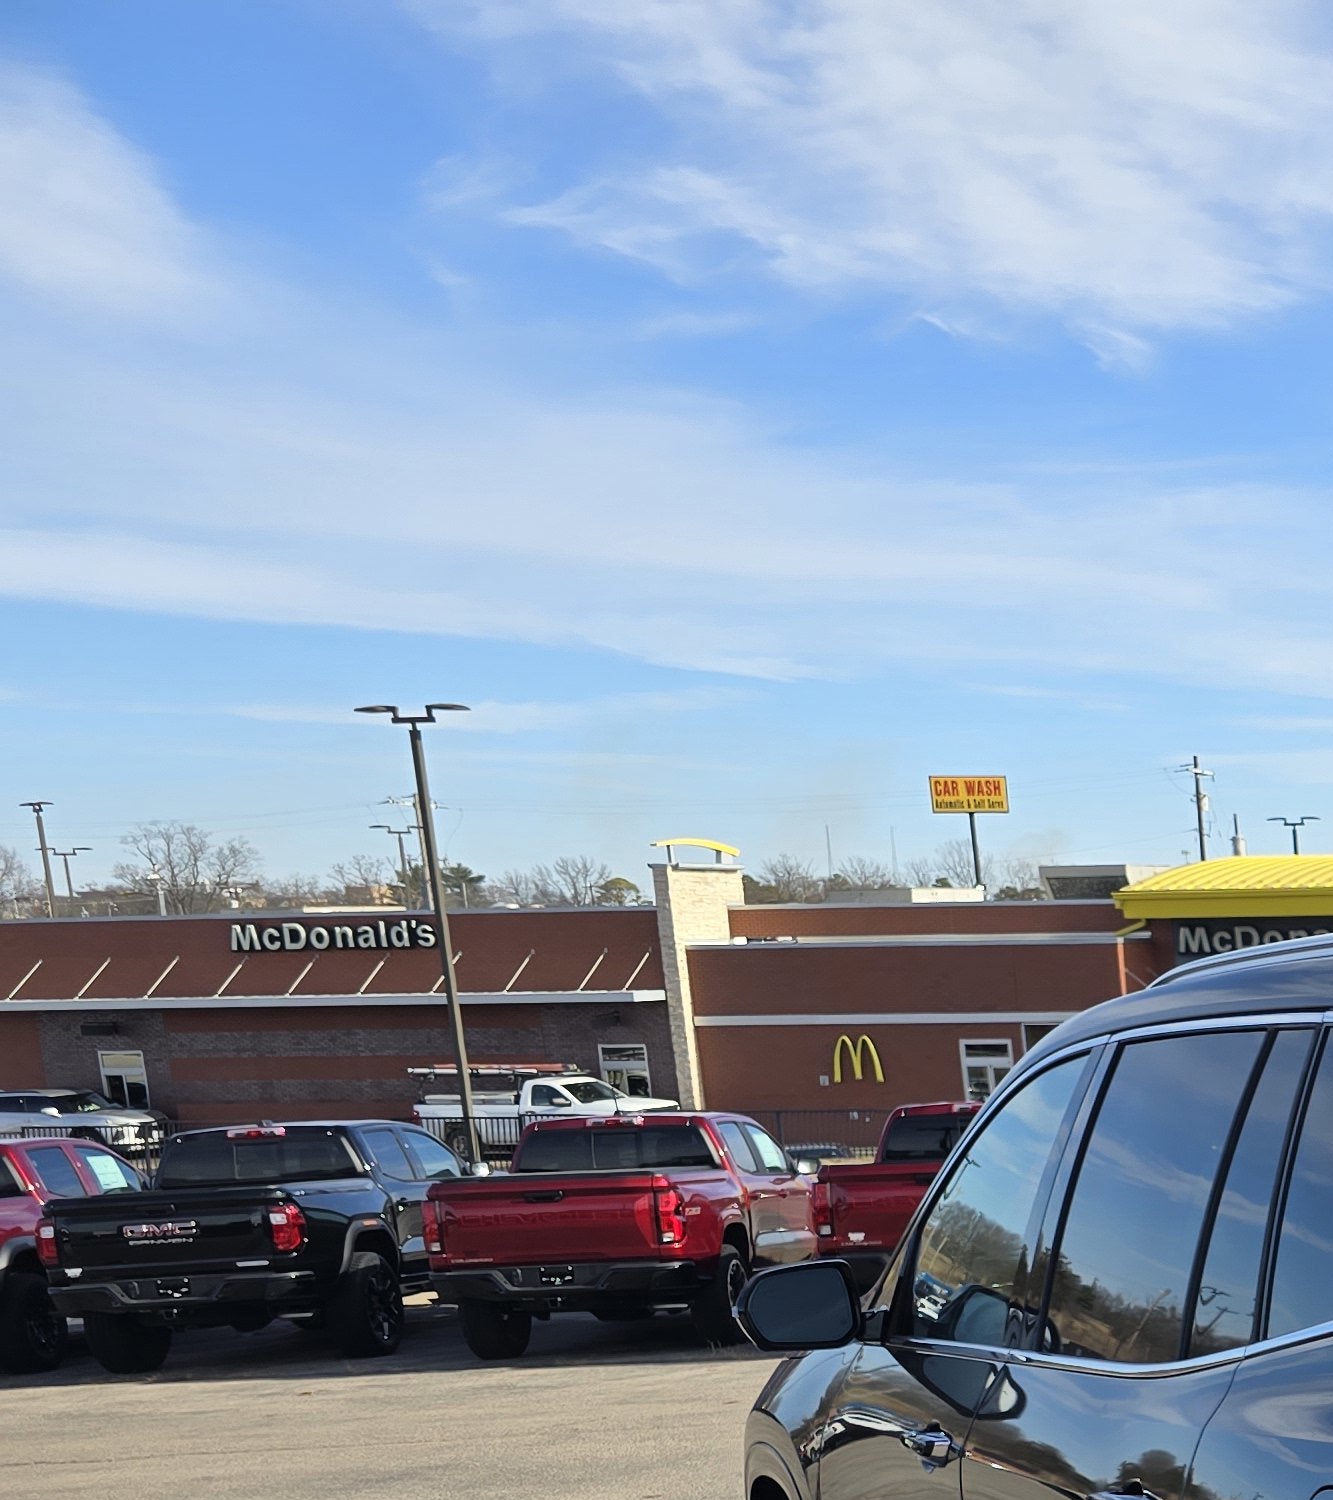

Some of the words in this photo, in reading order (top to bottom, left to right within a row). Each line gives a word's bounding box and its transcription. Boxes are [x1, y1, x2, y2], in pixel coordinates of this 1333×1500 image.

[934, 781, 959, 797] CAR
[964, 780, 1001, 797] WASH
[231, 920, 436, 951] McDonald's
[122, 1221, 197, 1238] GMC
